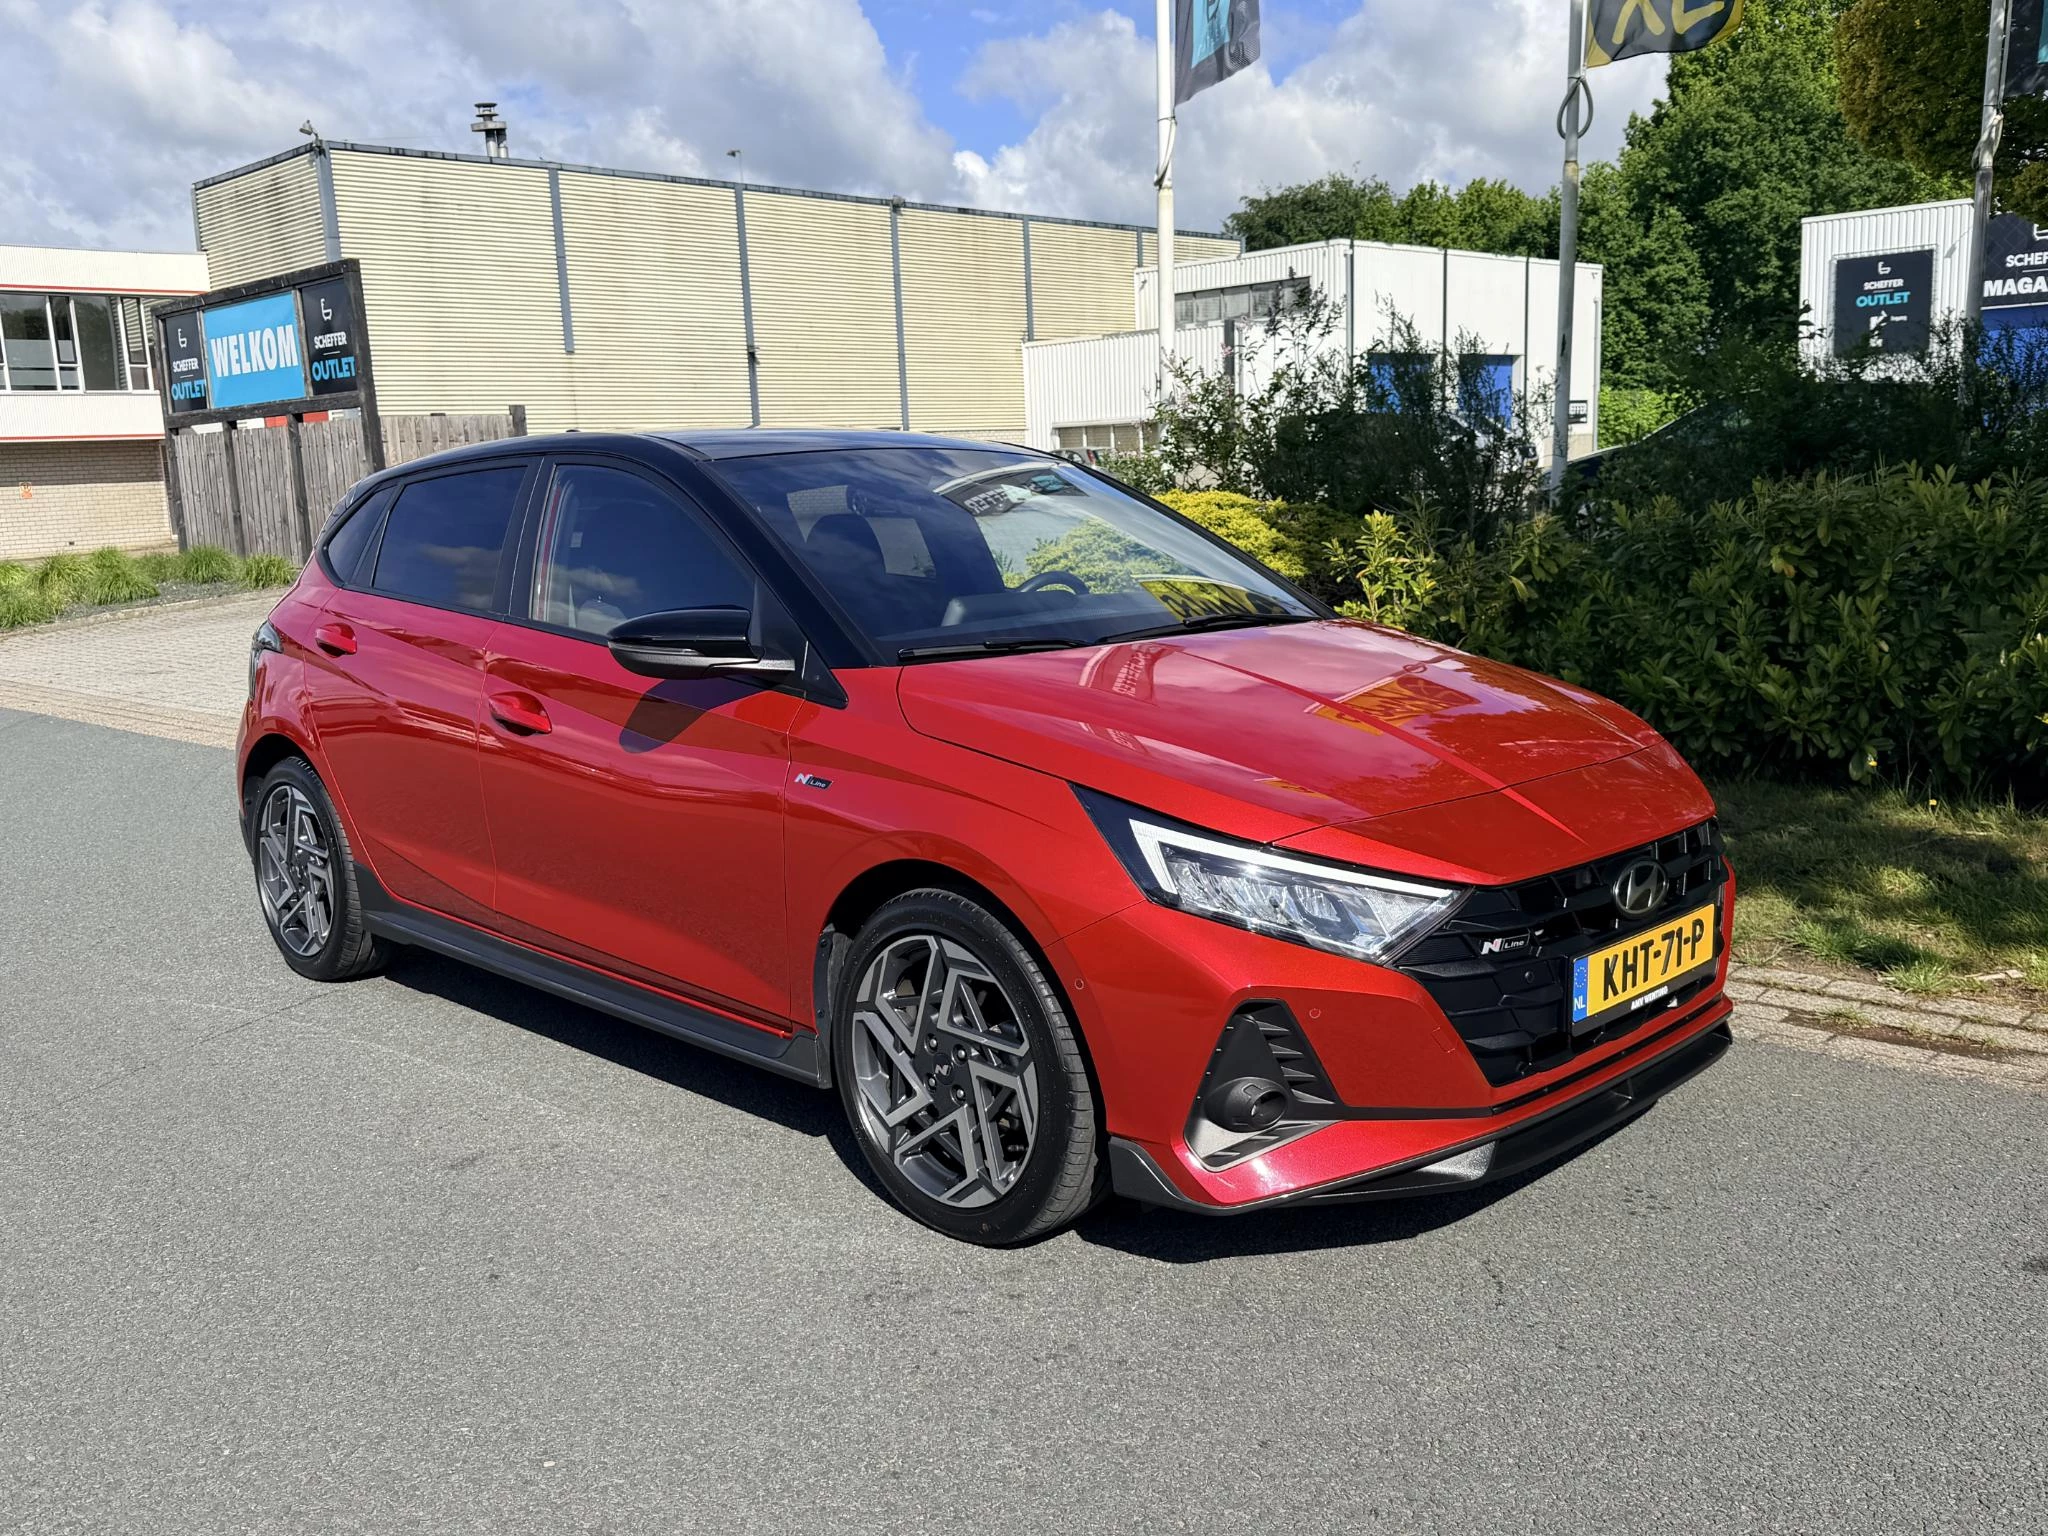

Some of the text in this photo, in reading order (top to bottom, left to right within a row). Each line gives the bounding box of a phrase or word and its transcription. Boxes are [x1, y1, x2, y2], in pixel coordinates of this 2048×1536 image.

[1864, 279, 1904, 290] SCHEFFER
[1856, 291, 1911, 307] OUTLET
[314, 332, 347, 349] SCHEFFER
[211, 325, 298, 377] WELKOM
[173, 358, 199, 372] SCHEFFER
[312, 357, 355, 381] OUTLET
[171, 380, 206, 400] OUTLET
[1504, 940, 1524, 949] Line
[1603, 918, 1705, 1001] KHT-71-P
[1573, 995, 1586, 1011] NL
